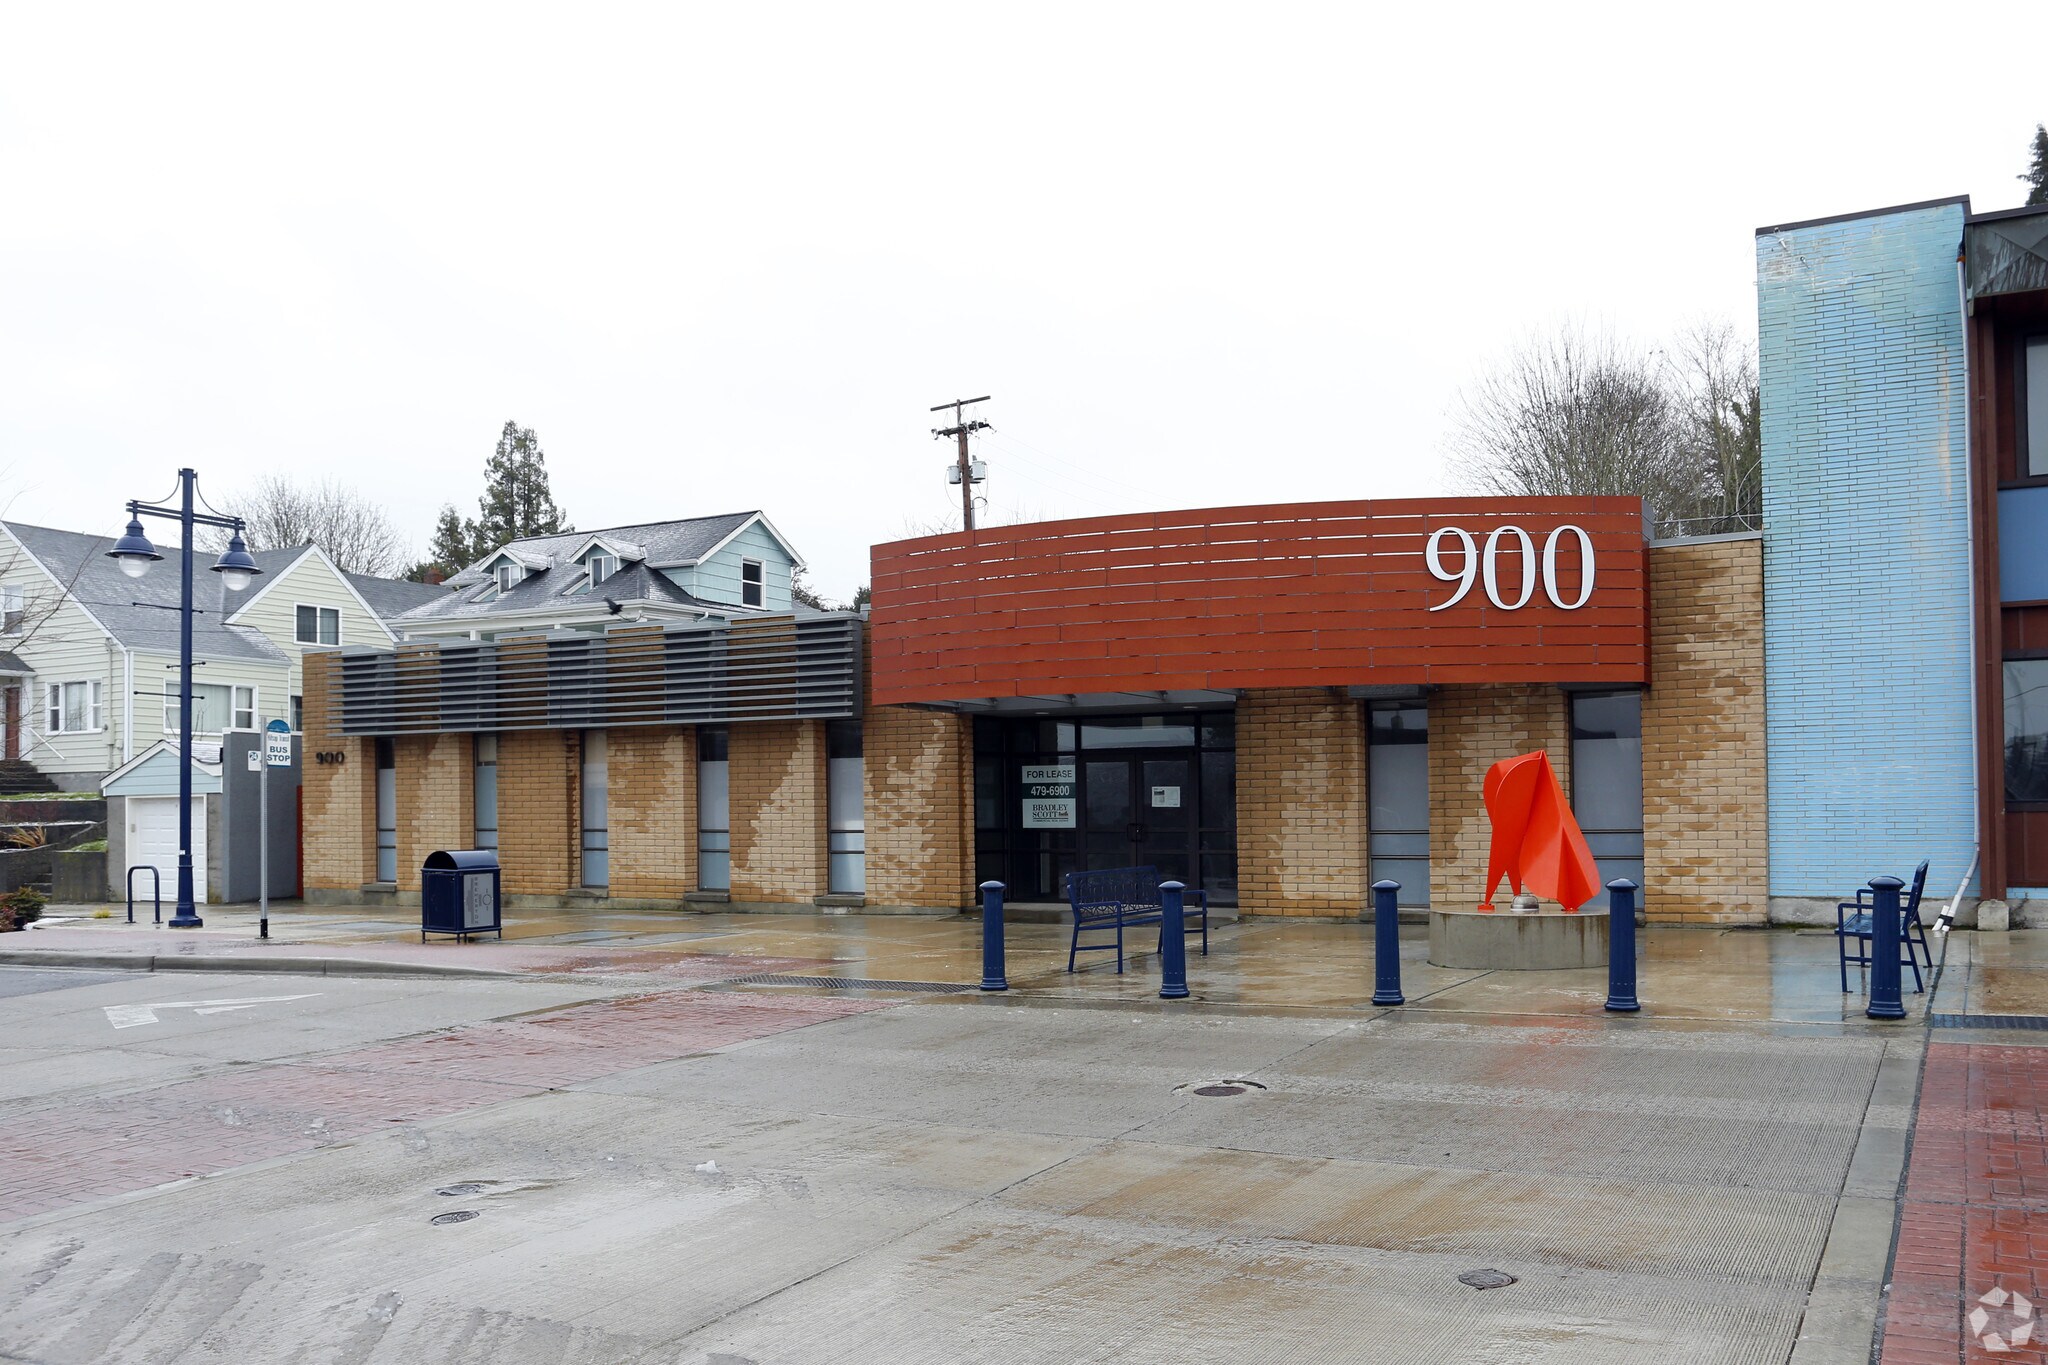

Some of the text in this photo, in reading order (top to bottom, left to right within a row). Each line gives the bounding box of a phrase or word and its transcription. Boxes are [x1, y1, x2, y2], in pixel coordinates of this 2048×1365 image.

[1425, 524, 1596, 612] 900
[269, 745, 288, 753] BUS
[267, 754, 290, 762] STOP
[315, 751, 345, 765] 900
[1027, 770, 1072, 778] FOR LEASE
[1030, 785, 1070, 796] 479-6900
[1032, 803, 1068, 811] BRADLEY
